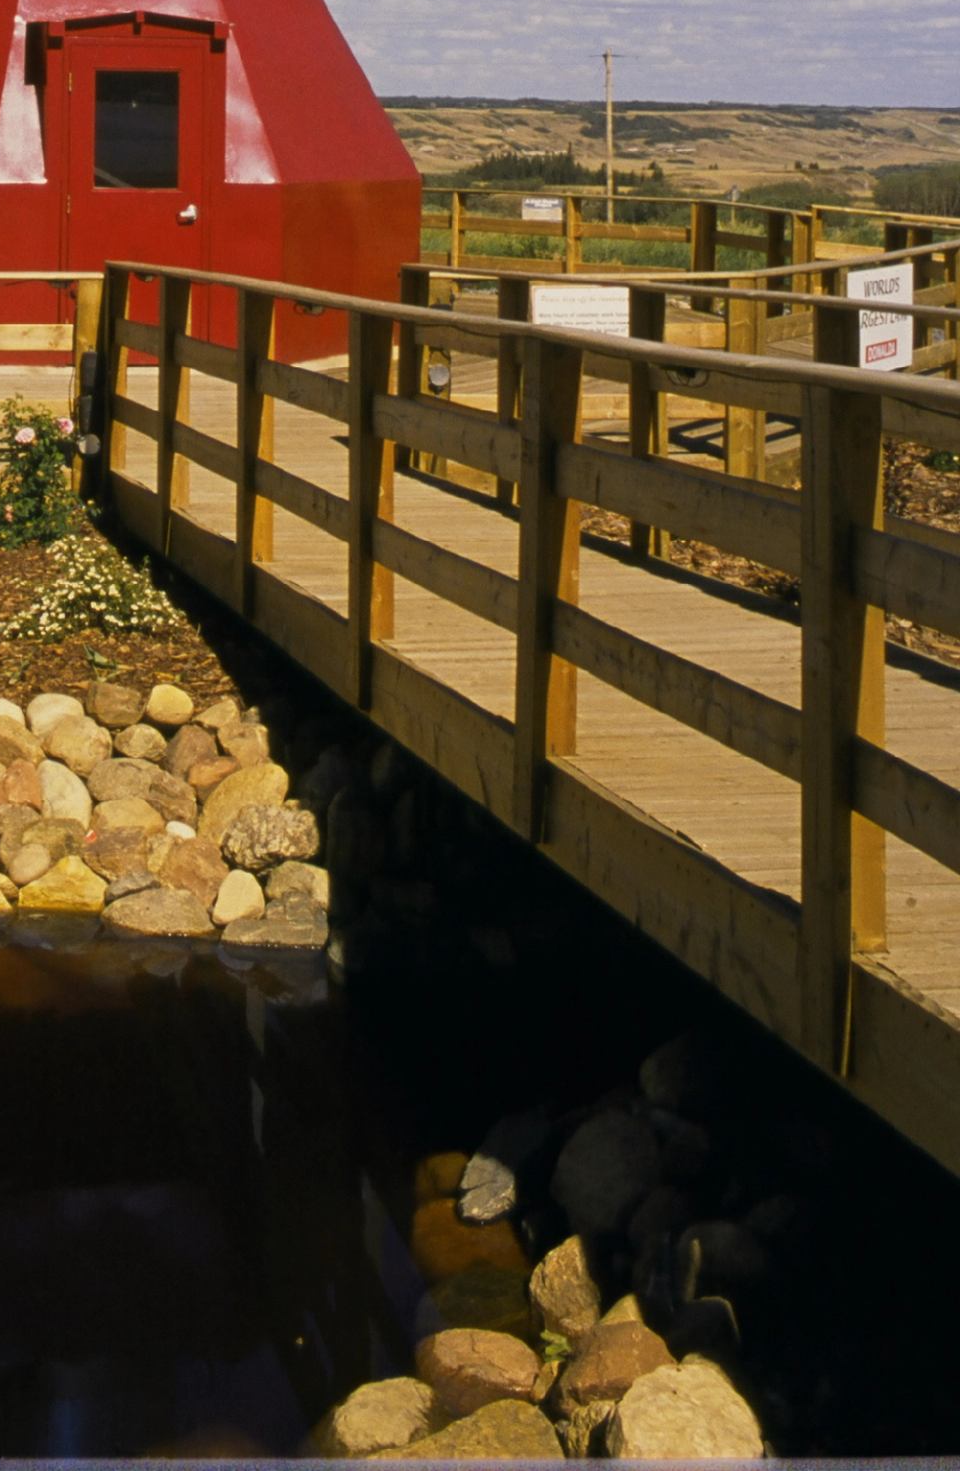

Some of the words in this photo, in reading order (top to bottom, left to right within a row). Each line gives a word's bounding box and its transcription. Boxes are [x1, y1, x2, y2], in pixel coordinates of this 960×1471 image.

[864, 277, 900, 297] WORLDS
[860, 312, 888, 329] RGEST
[868, 342, 895, 360] DONALDA
